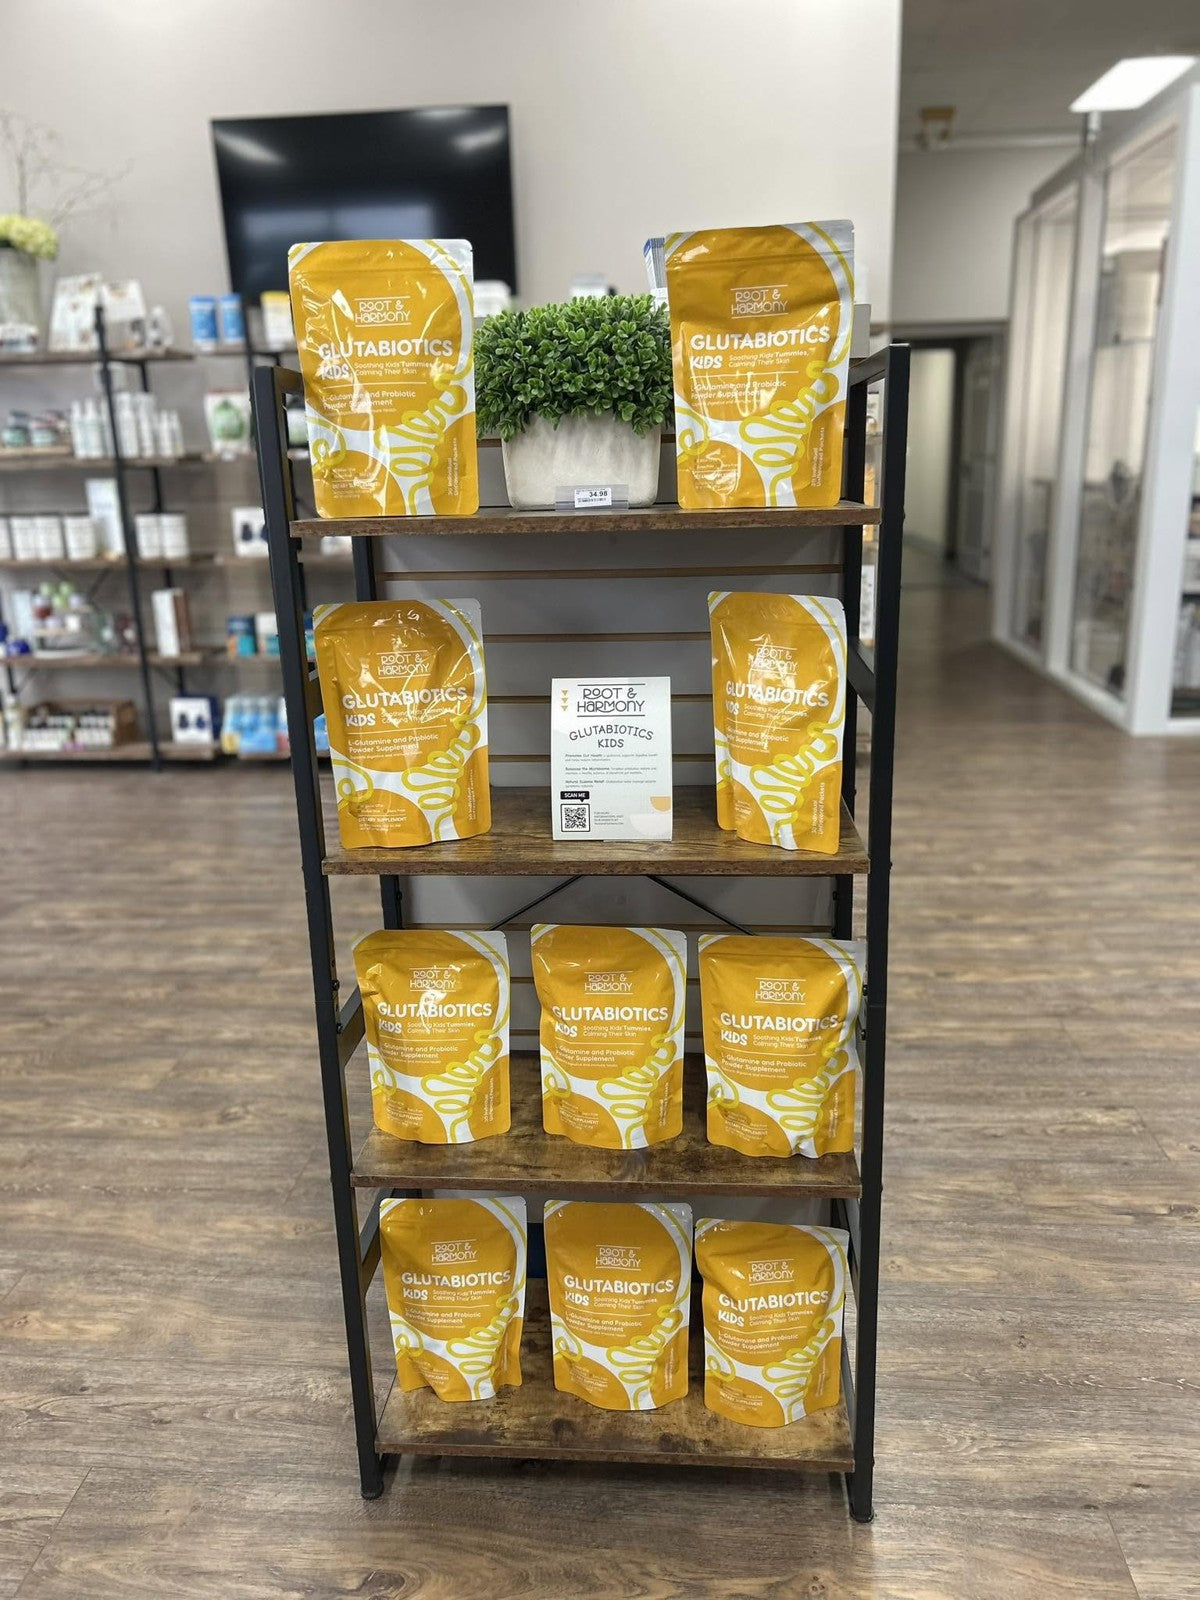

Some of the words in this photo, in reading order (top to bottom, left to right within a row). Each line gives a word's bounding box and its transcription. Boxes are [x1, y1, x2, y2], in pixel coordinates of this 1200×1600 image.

[735, 290, 769, 302] ROOT
[772, 289, 781, 300] &
[395, 300, 404, 310] &
[731, 301, 788, 314] HARMONY
[690, 324, 830, 350] GLUTABIOTICS
[319, 338, 453, 359] GLUTABIOTICS
[691, 355, 723, 369] KIDS
[322, 364, 349, 380] KIDS
[382, 390, 416, 398] Probiotic
[342, 687, 468, 709] GLUTABIOTICS
[583, 688, 623, 700] ROOT
[627, 687, 637, 698] &
[726, 680, 829, 707] GLUTABIOTICS
[577, 700, 645, 713] HARMONY
[345, 713, 376, 727] KIDS
[393, 736, 407, 744] and
[569, 724, 654, 741] GLUTABIOTICS
[598, 739, 625, 748] KIDS
[585, 982, 633, 992] HARMONY
[792, 982, 800, 991] &
[755, 990, 806, 1001] HARMONY
[377, 1002, 492, 1018] GLUTABIOTICS
[552, 1006, 669, 1022] GLUTABIOTICS
[379, 1019, 402, 1034] KIDS
[555, 1021, 578, 1037] KIDS
[720, 1012, 838, 1032] GLUTABIOTICS
[721, 1030, 747, 1046] KIDS
[401, 1270, 511, 1288] GLUTABIOTICS
[564, 1275, 674, 1295] GLUTABIOTICS
[403, 1288, 428, 1300] KIDS
[565, 1291, 589, 1306] KIDS
[719, 1291, 829, 1313] GLUTABIOTICS
[718, 1310, 745, 1327] KIDS
